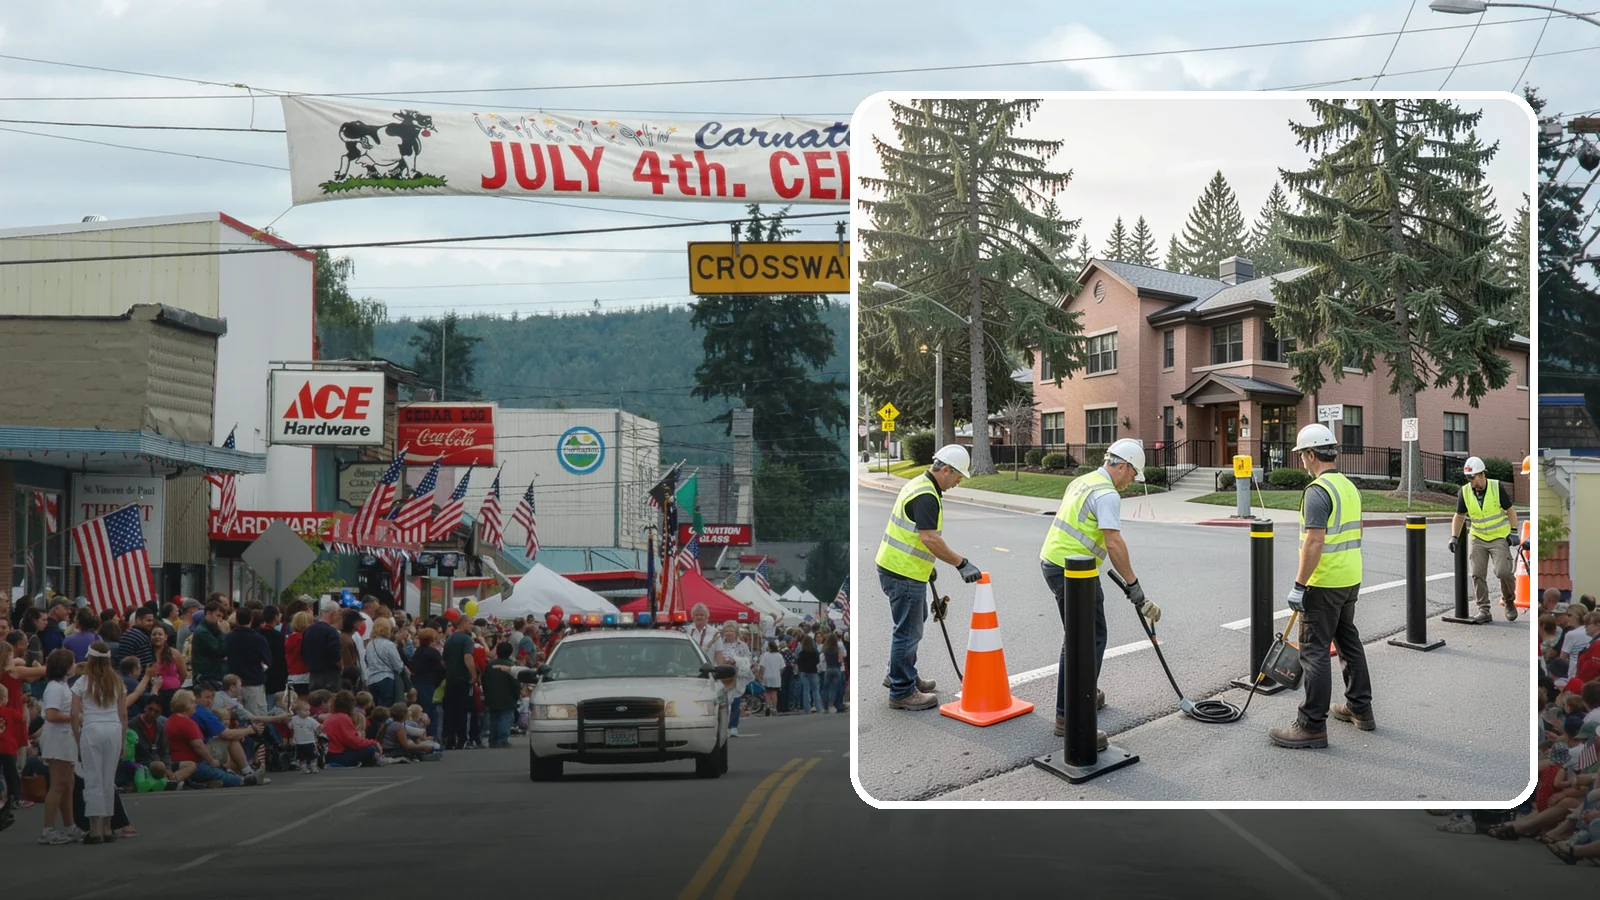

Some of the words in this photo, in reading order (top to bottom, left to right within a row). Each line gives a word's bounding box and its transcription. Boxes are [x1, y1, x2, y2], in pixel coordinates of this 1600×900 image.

[481, 140, 605, 193] JULY
[632, 149, 746, 198] 4th.
[697, 254, 850, 280] CROSSWA
[282, 380, 373, 420] ACE
[406, 409, 453, 422] CEDAR
[461, 409, 485, 421] LOG
[283, 421, 371, 436] Hardware
[416, 428, 477, 447] Coca-Cola
[353, 466, 387, 480] Simpl
[95, 485, 124, 495] Vincent
[126, 486, 136, 495] de
[138, 486, 155, 495] Paul
[688, 526, 741, 535] CRNATION
[699, 535, 730, 543] GLASS
